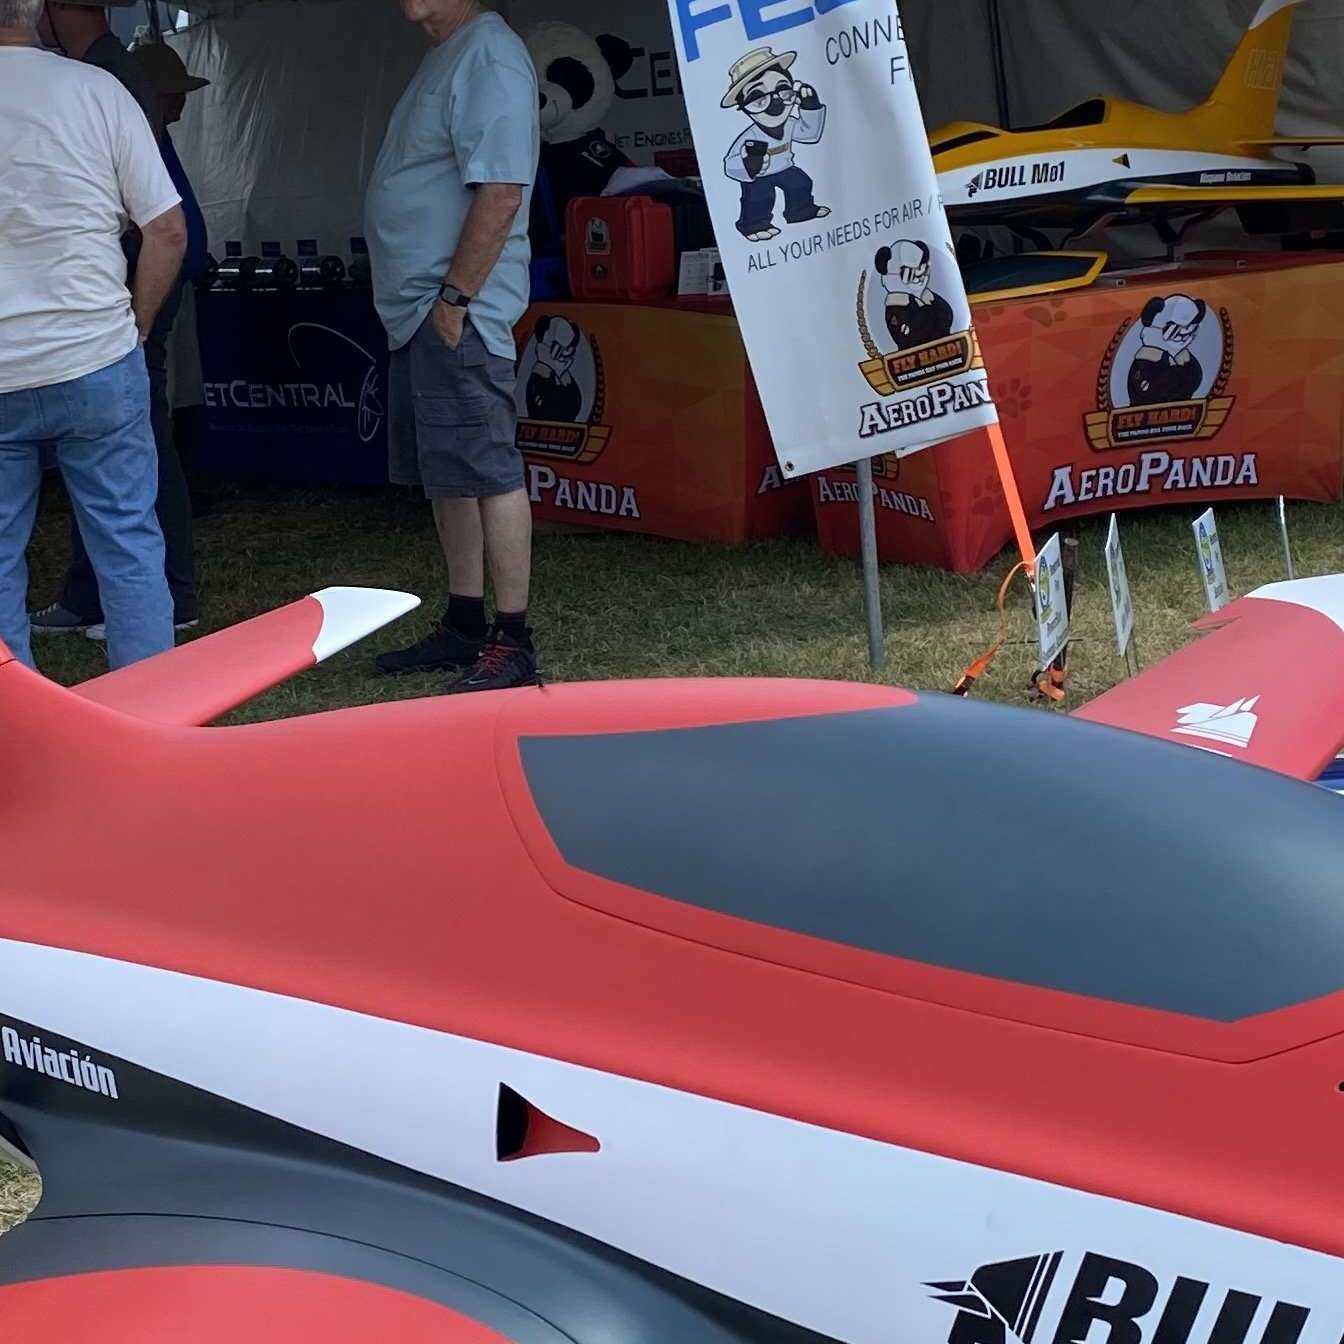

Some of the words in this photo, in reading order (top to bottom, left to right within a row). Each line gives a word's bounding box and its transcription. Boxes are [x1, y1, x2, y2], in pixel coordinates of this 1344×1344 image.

[983, 164, 1027, 190] BULL
[747, 249, 777, 273] ALL
[779, 234, 824, 263] YOUR
[826, 218, 872, 249] NEEDS
[874, 206, 899, 233] FOR
[902, 198, 923, 223] AIR
[1, 1025, 120, 1100] Aviación
